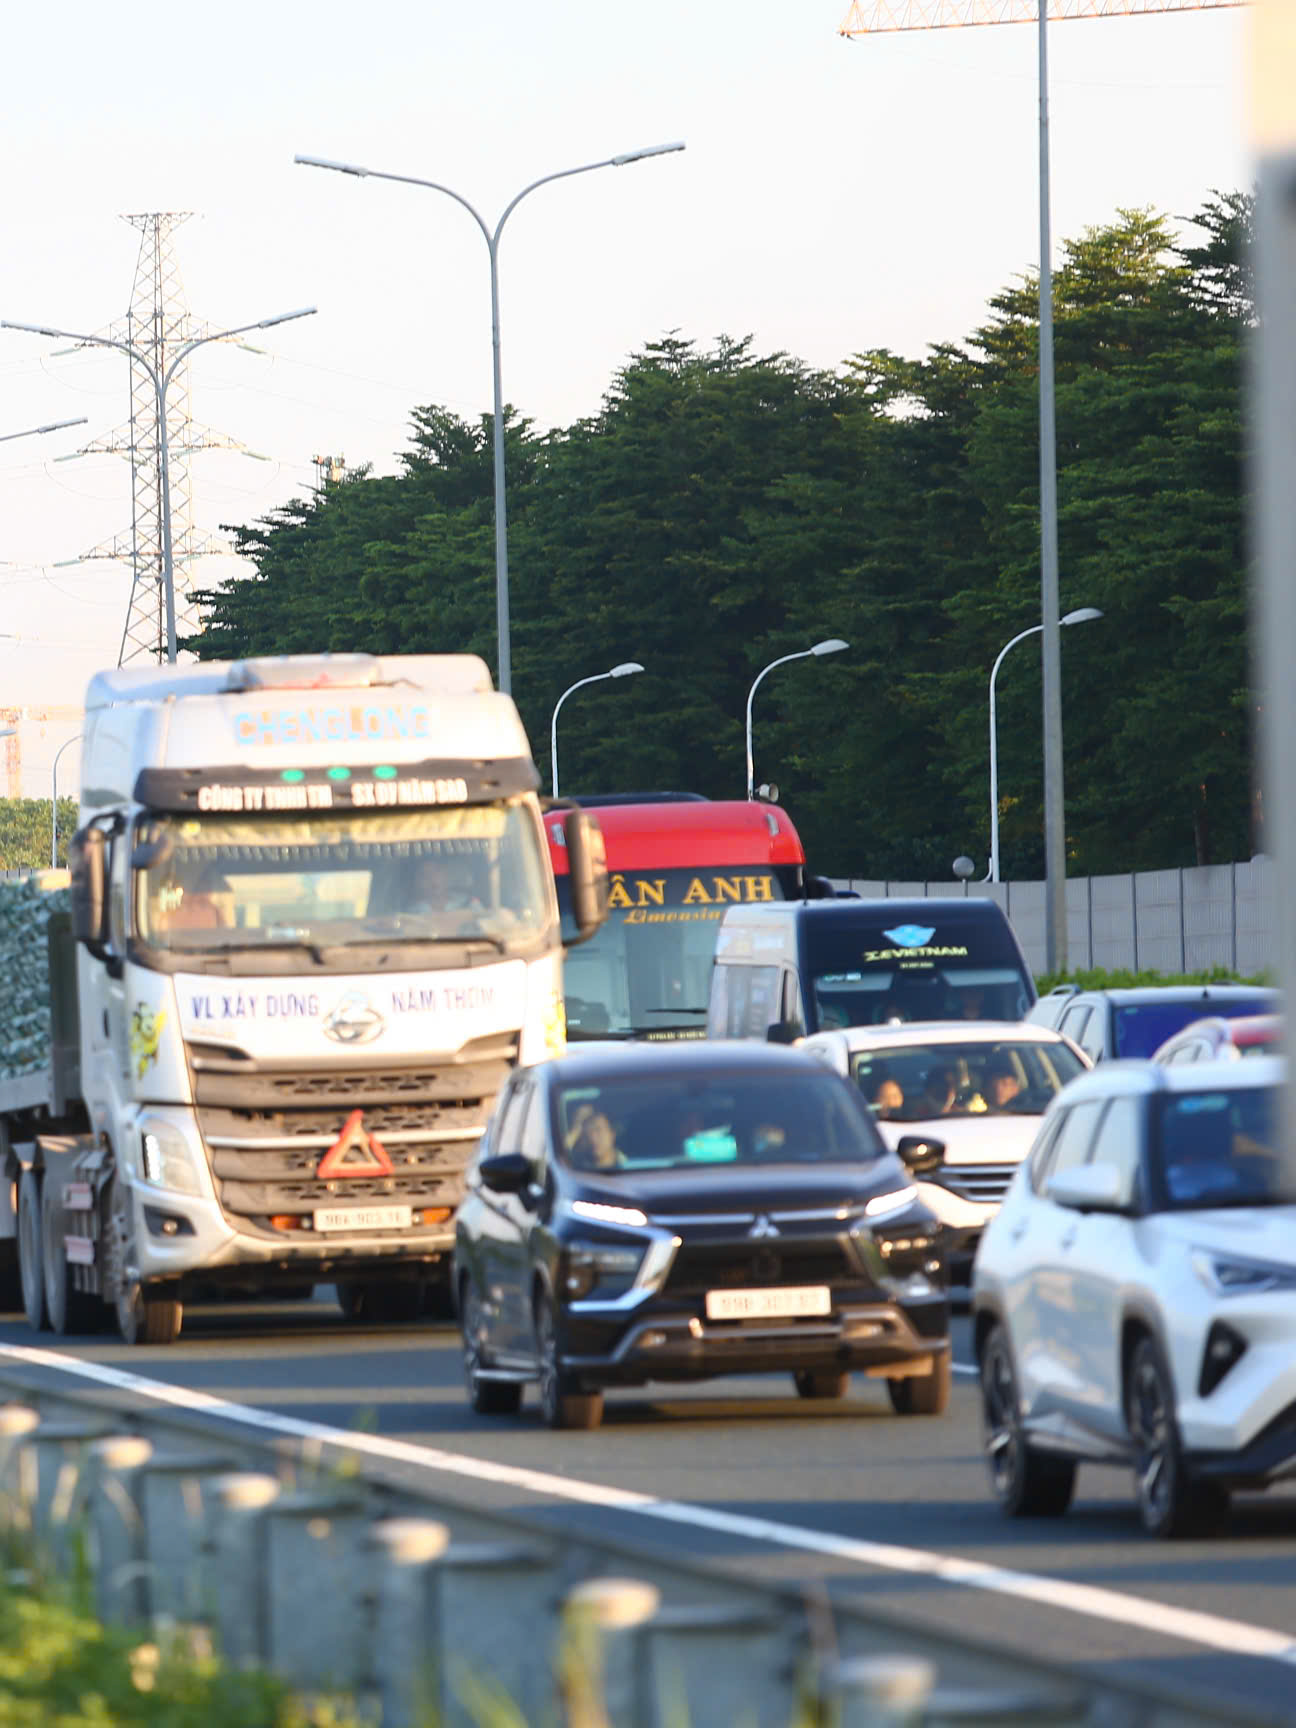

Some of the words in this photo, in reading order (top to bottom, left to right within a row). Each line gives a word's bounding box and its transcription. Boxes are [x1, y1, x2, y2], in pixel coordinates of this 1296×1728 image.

[234, 704, 431, 748] CHENGLONG
[607, 874, 666, 908] ÂN
[683, 876, 774, 905] ANH
[623, 909, 721, 924] Limousin
